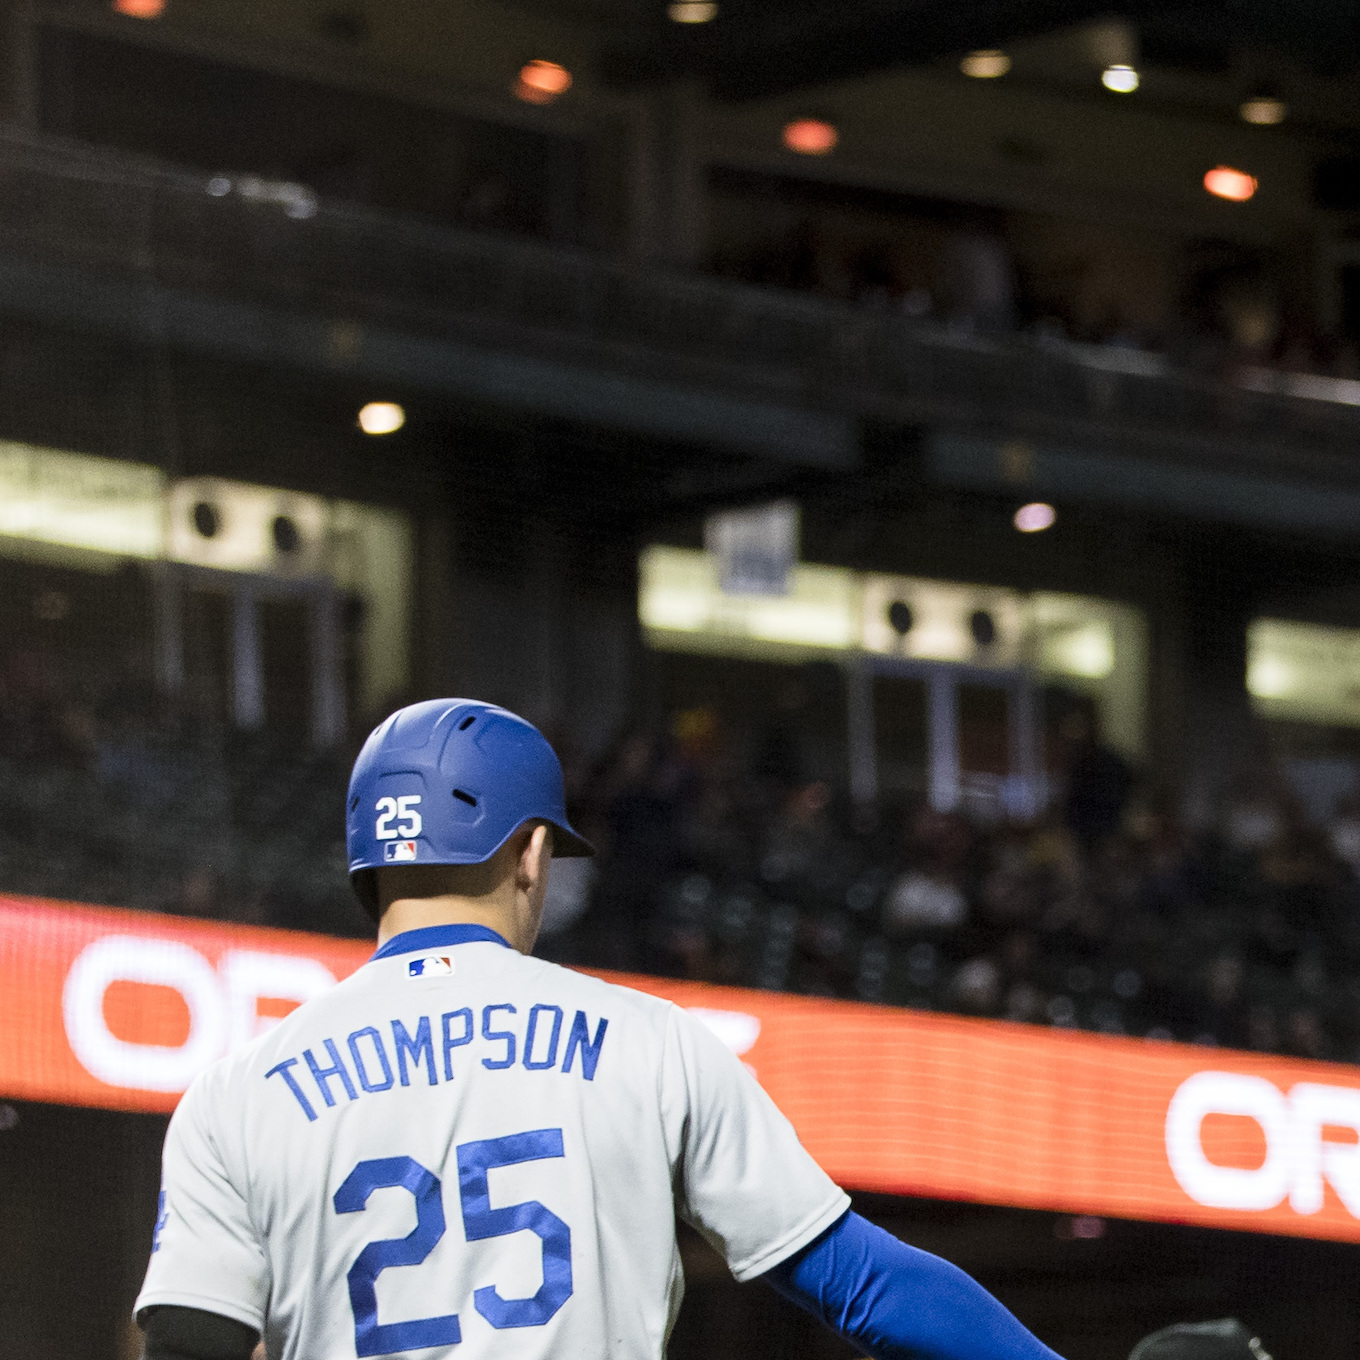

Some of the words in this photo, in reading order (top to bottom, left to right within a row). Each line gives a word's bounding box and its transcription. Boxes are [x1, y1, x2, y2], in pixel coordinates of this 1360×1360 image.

[375, 795, 423, 841] 25
[265, 1003, 609, 1122] THOMPSON
[333, 1128, 575, 1358] 25
